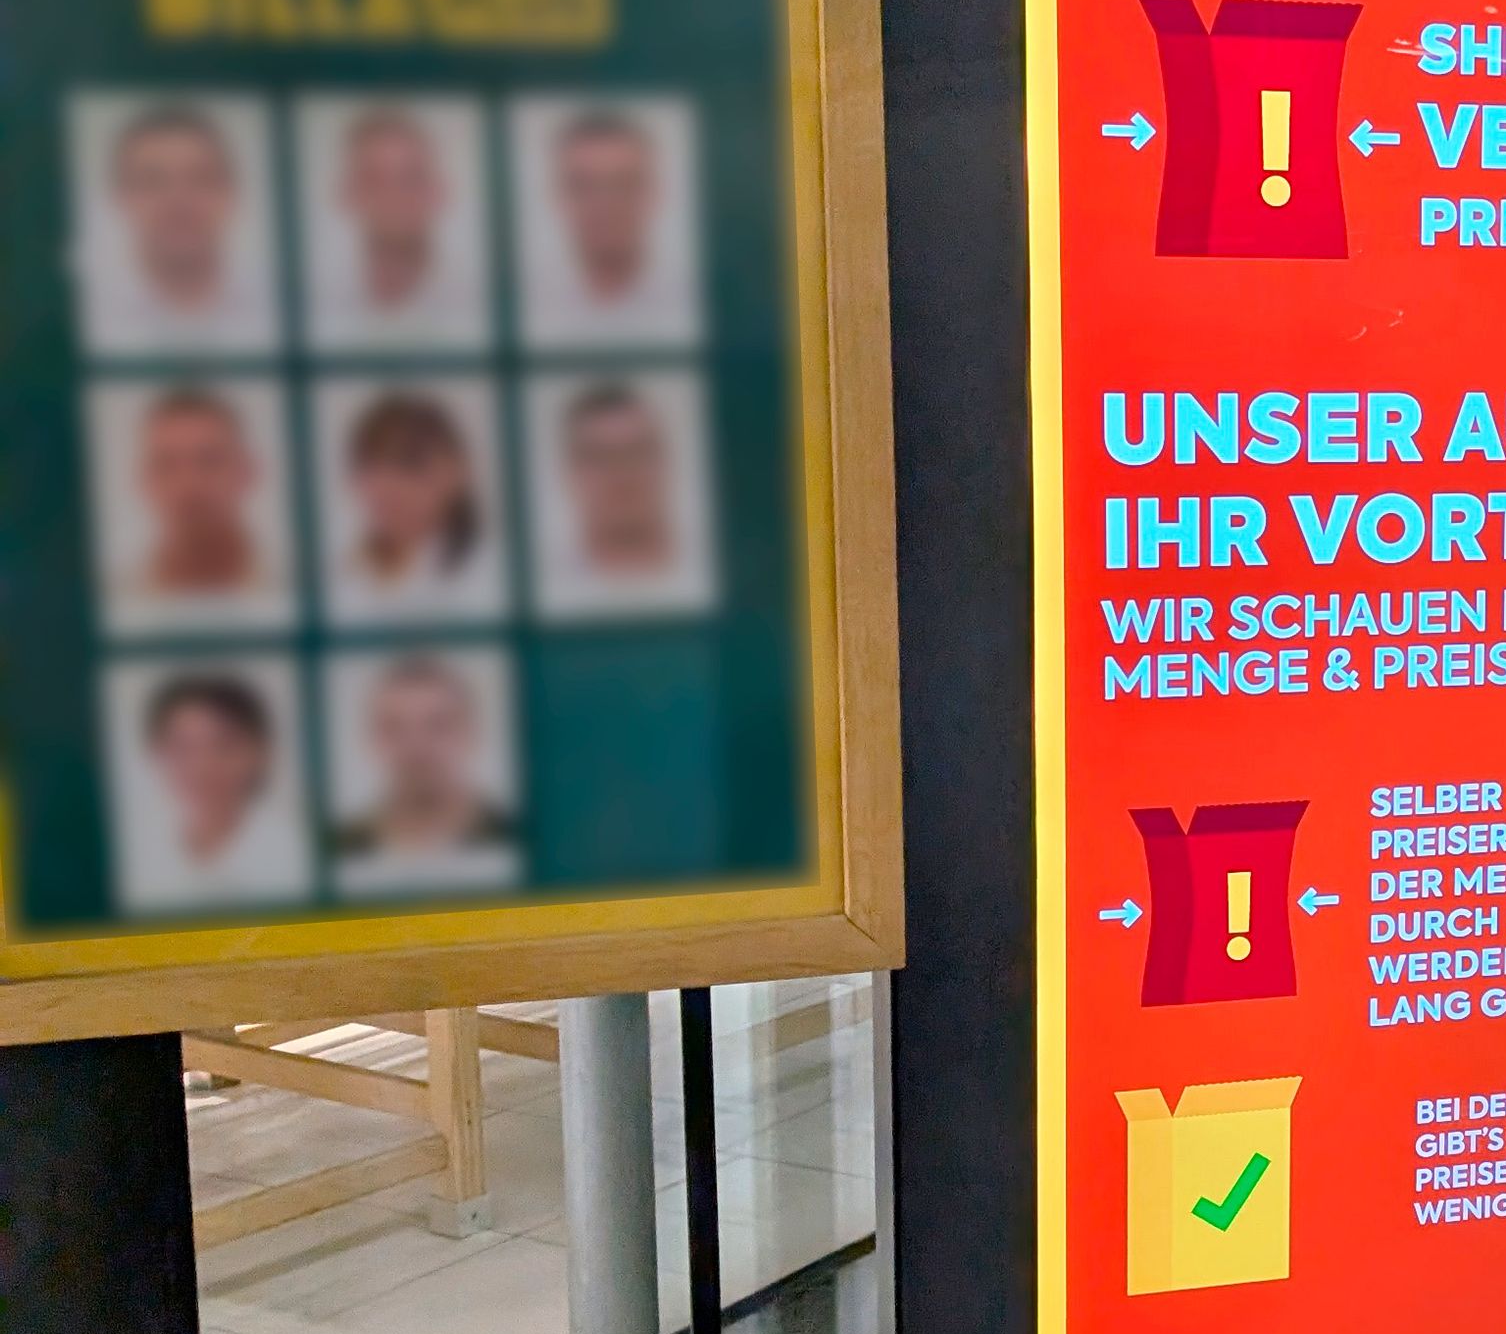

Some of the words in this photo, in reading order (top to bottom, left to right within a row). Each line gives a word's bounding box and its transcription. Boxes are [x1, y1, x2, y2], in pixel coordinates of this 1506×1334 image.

[1104, 392, 1423, 465] UNSER
[1106, 496, 1268, 569] IHR
[1100, 598, 1214, 643] WIR
[1228, 590, 1486, 640] SCHAUEN
[1105, 649, 1308, 700] MENGE
[1323, 648, 1360, 691] &
[1370, 782, 1502, 819] SELBER
[1371, 869, 1443, 901] DER
[1371, 907, 1498, 943] DURCH
[1370, 991, 1471, 1026] LANG
[1417, 1098, 1460, 1124] BEI
[1416, 1127, 1504, 1157] GIBT’S
